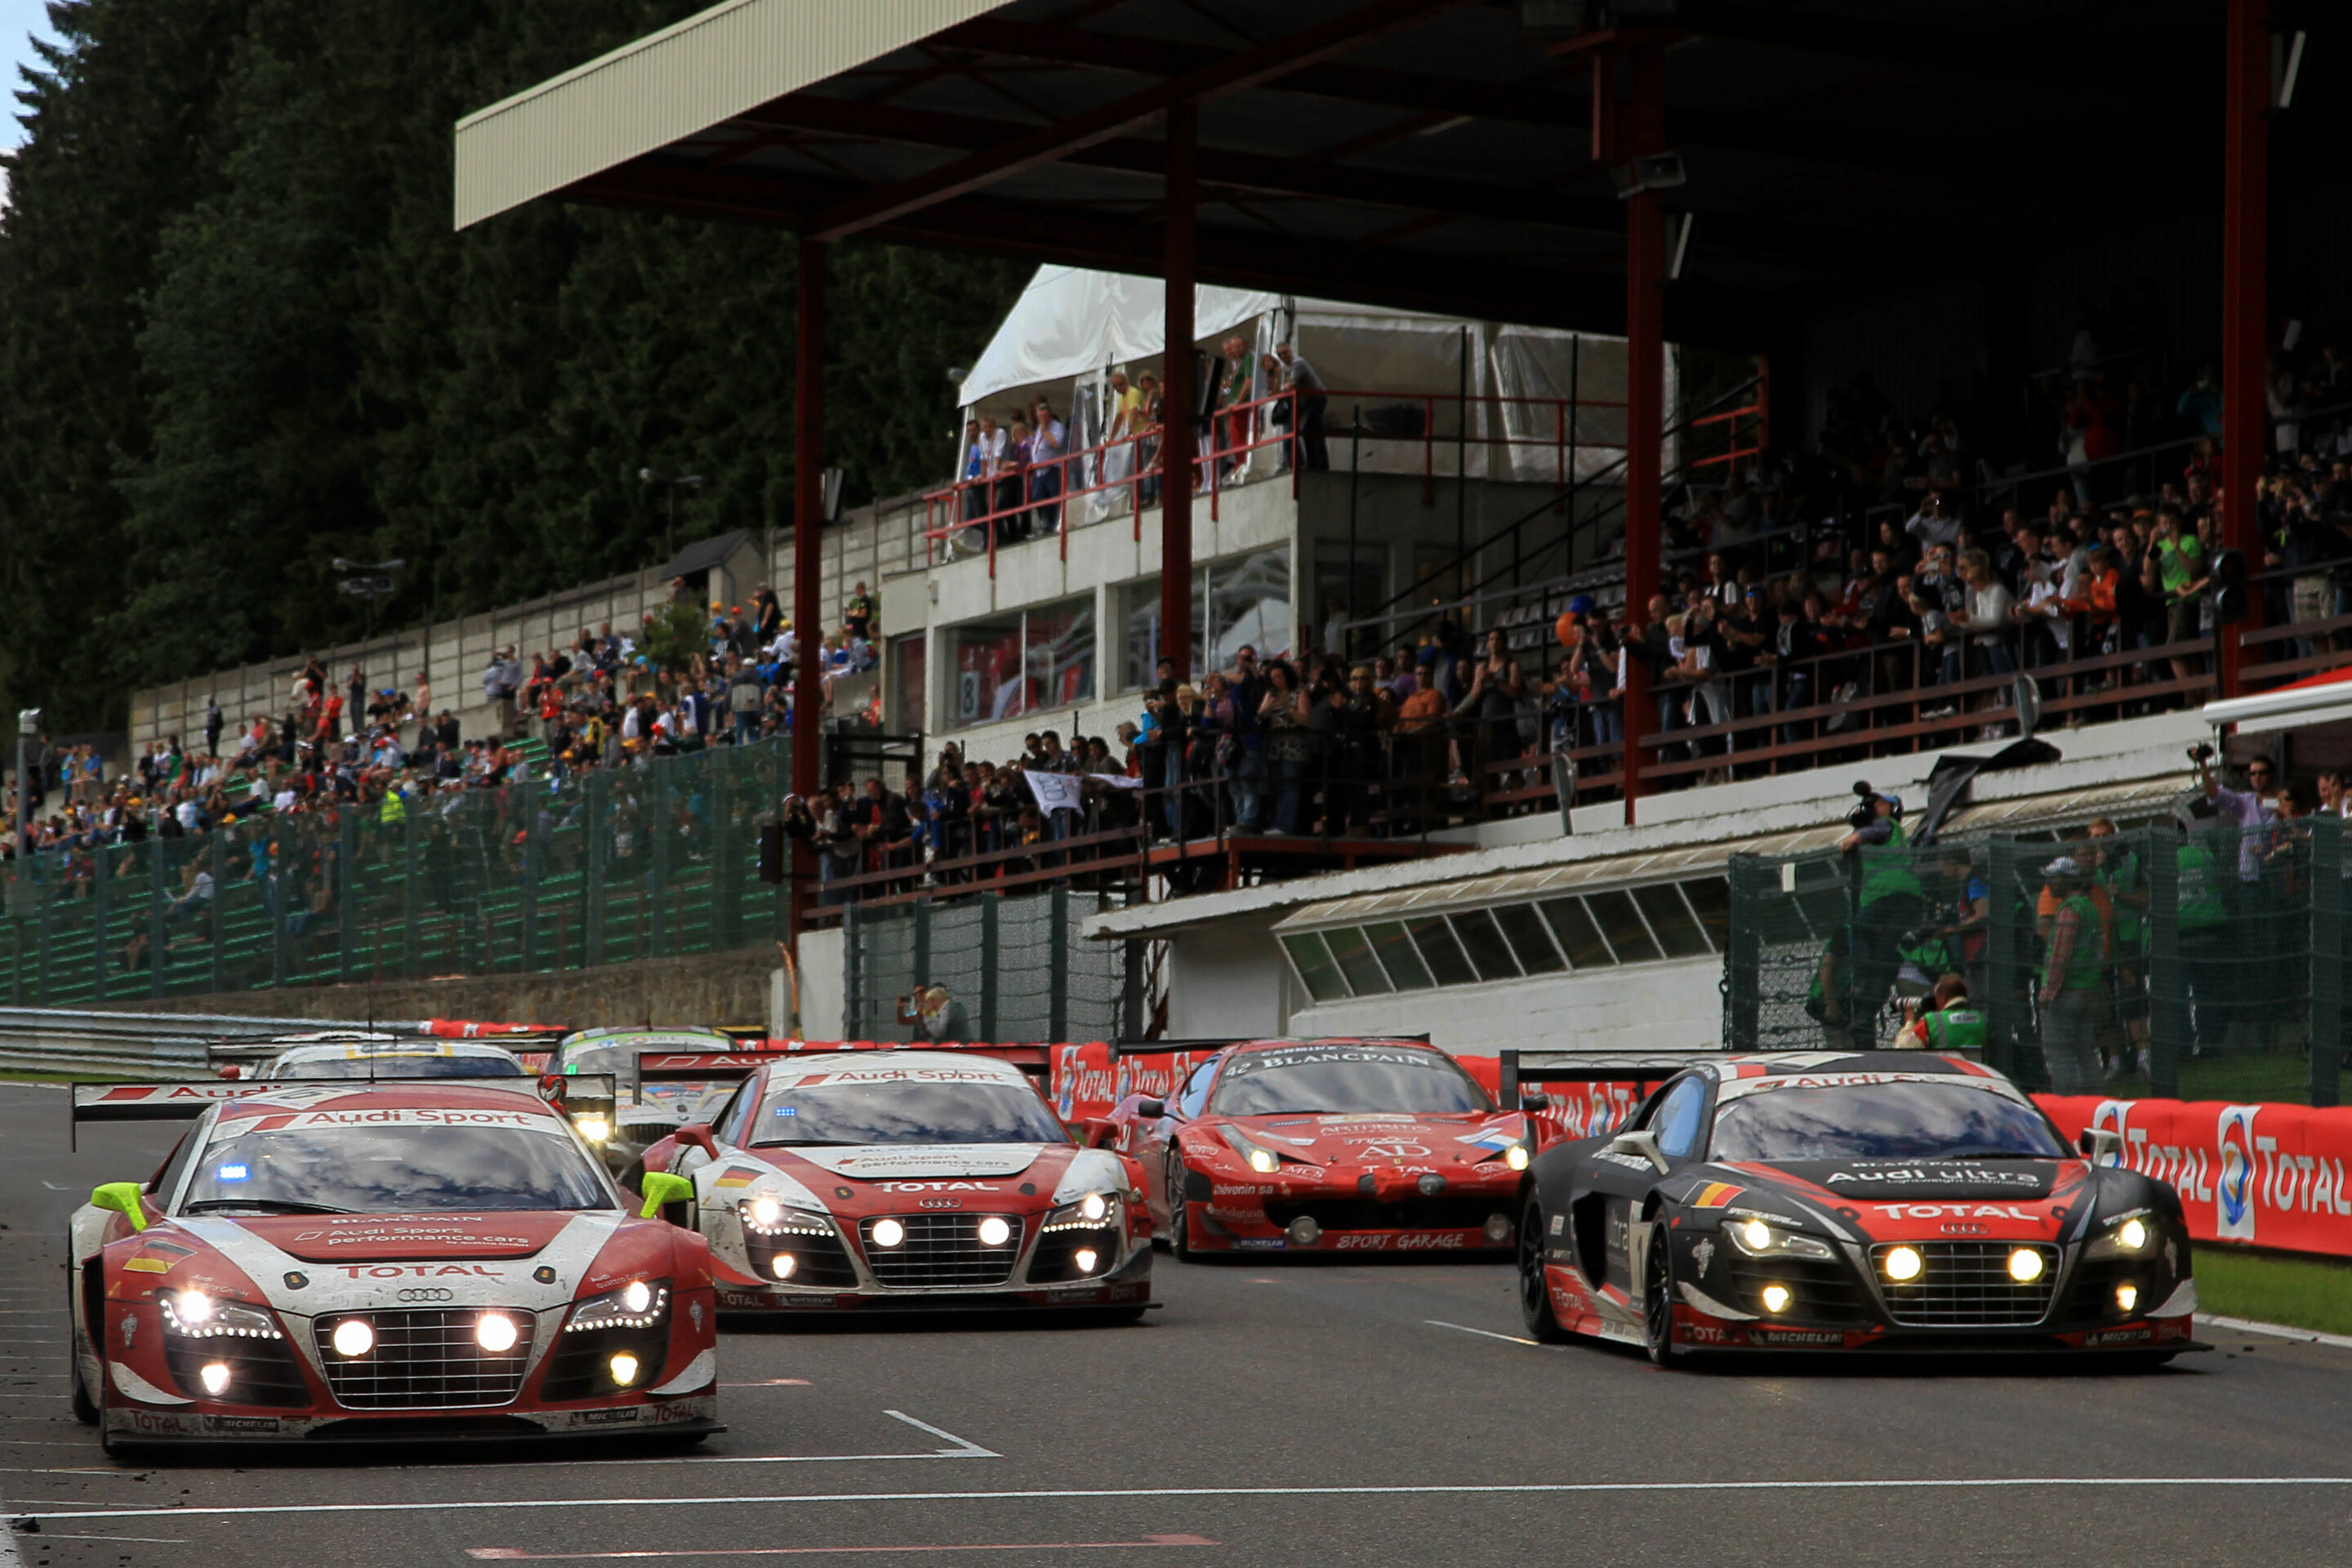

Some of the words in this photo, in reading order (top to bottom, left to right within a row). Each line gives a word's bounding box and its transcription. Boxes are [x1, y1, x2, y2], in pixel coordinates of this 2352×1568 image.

[1263, 1054, 1430, 1068] BLANCPAIN
[837, 1071, 908, 1081] Audi
[917, 1070, 1005, 1082] Sport
[1225, 1063, 1251, 1076] 42
[1077, 1061, 1114, 1102] TOTAL
[1798, 1074, 1881, 1087] Audi
[305, 1111, 402, 1125] Audi
[416, 1110, 532, 1126] Sport
[1356, 1145, 1432, 1159] AD
[1827, 1169, 1925, 1184] Audi
[1939, 1169, 2039, 1183] ultra
[2256, 1135, 2352, 1216] TOTAL
[875, 1181, 1000, 1192] TOTAL
[1259, 1185, 1274, 1195] sa
[1873, 1204, 2040, 1221] TOTAL
[331, 1215, 483, 1224] BLANCPAIN
[329, 1227, 385, 1236] Audi
[328, 1234, 476, 1245] performance
[483, 1235, 529, 1244] cars
[1337, 1234, 1391, 1250] SPORT
[1397, 1233, 1464, 1250] GARAGE
[337, 1265, 504, 1278] TOTAL
[718, 1290, 765, 1306] TOTAL
[1767, 1332, 1843, 1343] MICHELIN
[653, 1404, 693, 1422] TOTAL
[130, 1410, 189, 1432] TOTAL
[222, 1419, 277, 1428] MICHELIN
